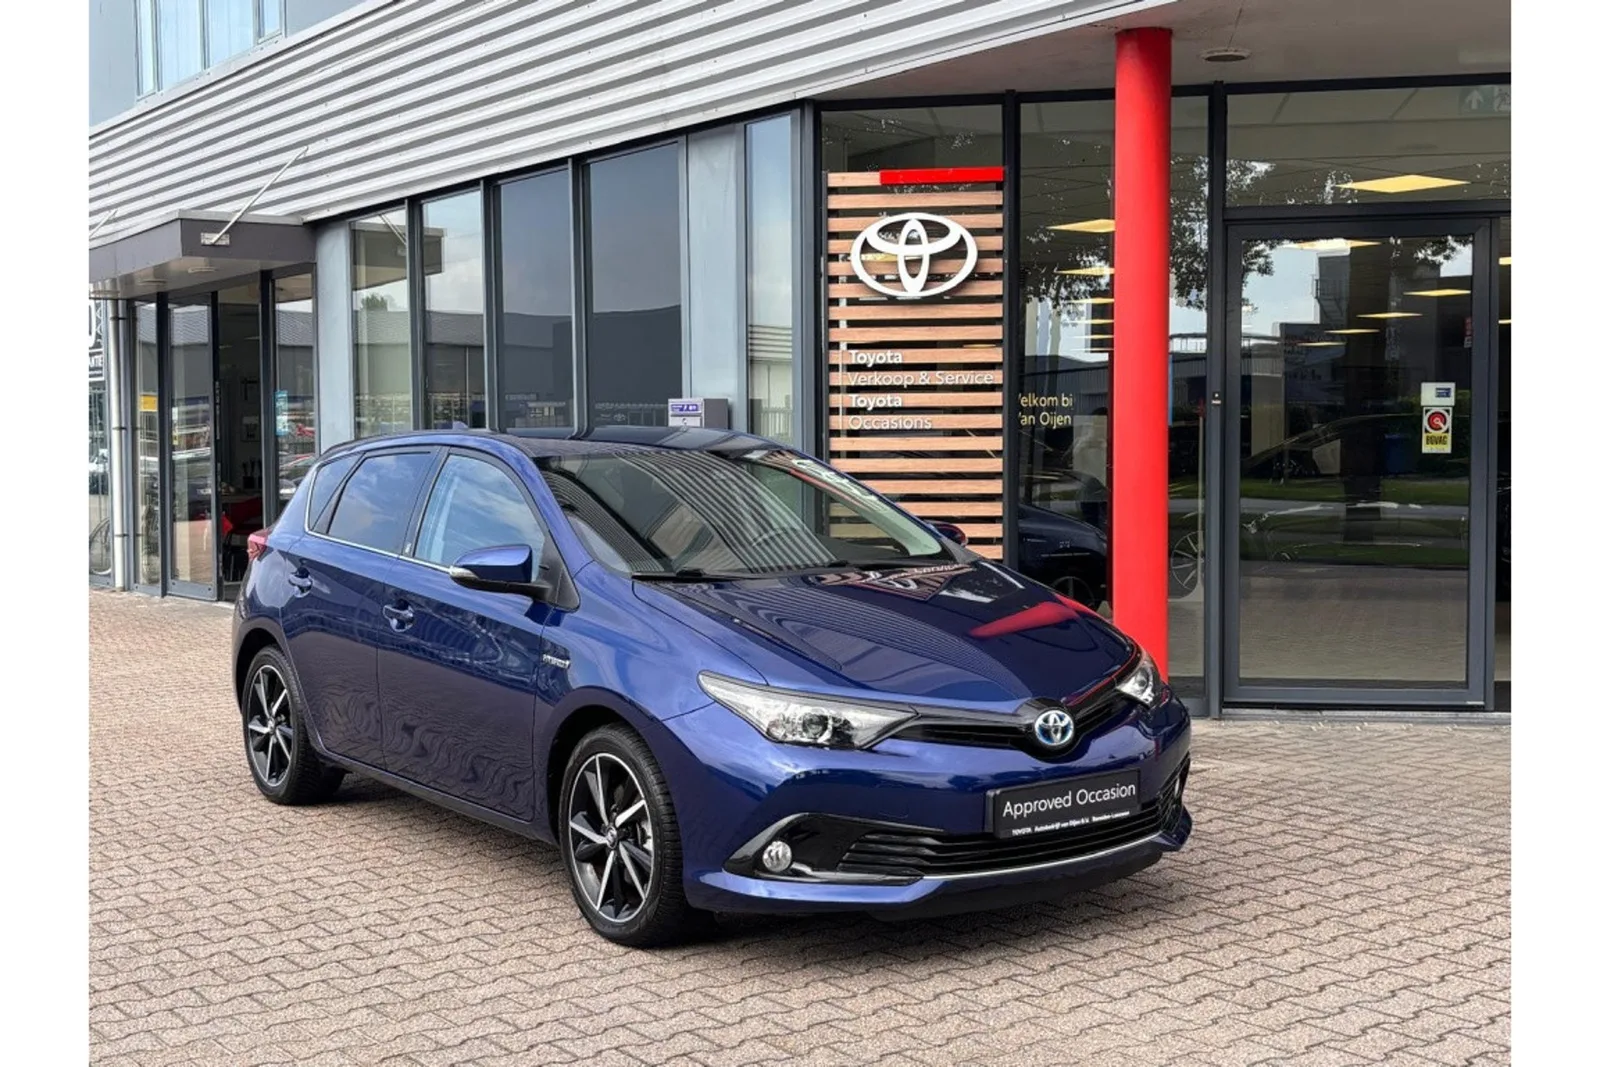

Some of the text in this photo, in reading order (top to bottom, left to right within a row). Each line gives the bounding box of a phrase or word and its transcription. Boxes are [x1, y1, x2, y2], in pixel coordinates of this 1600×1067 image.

[849, 350, 902, 367] Toyota
[848, 371, 994, 388] Verkoop & Service
[849, 394, 902, 411] Toyota
[849, 415, 932, 430] Occasions
[1039, 411, 1072, 429] Oijen
[1002, 790, 1072, 819] Approved
[1076, 783, 1136, 805] Occasion
